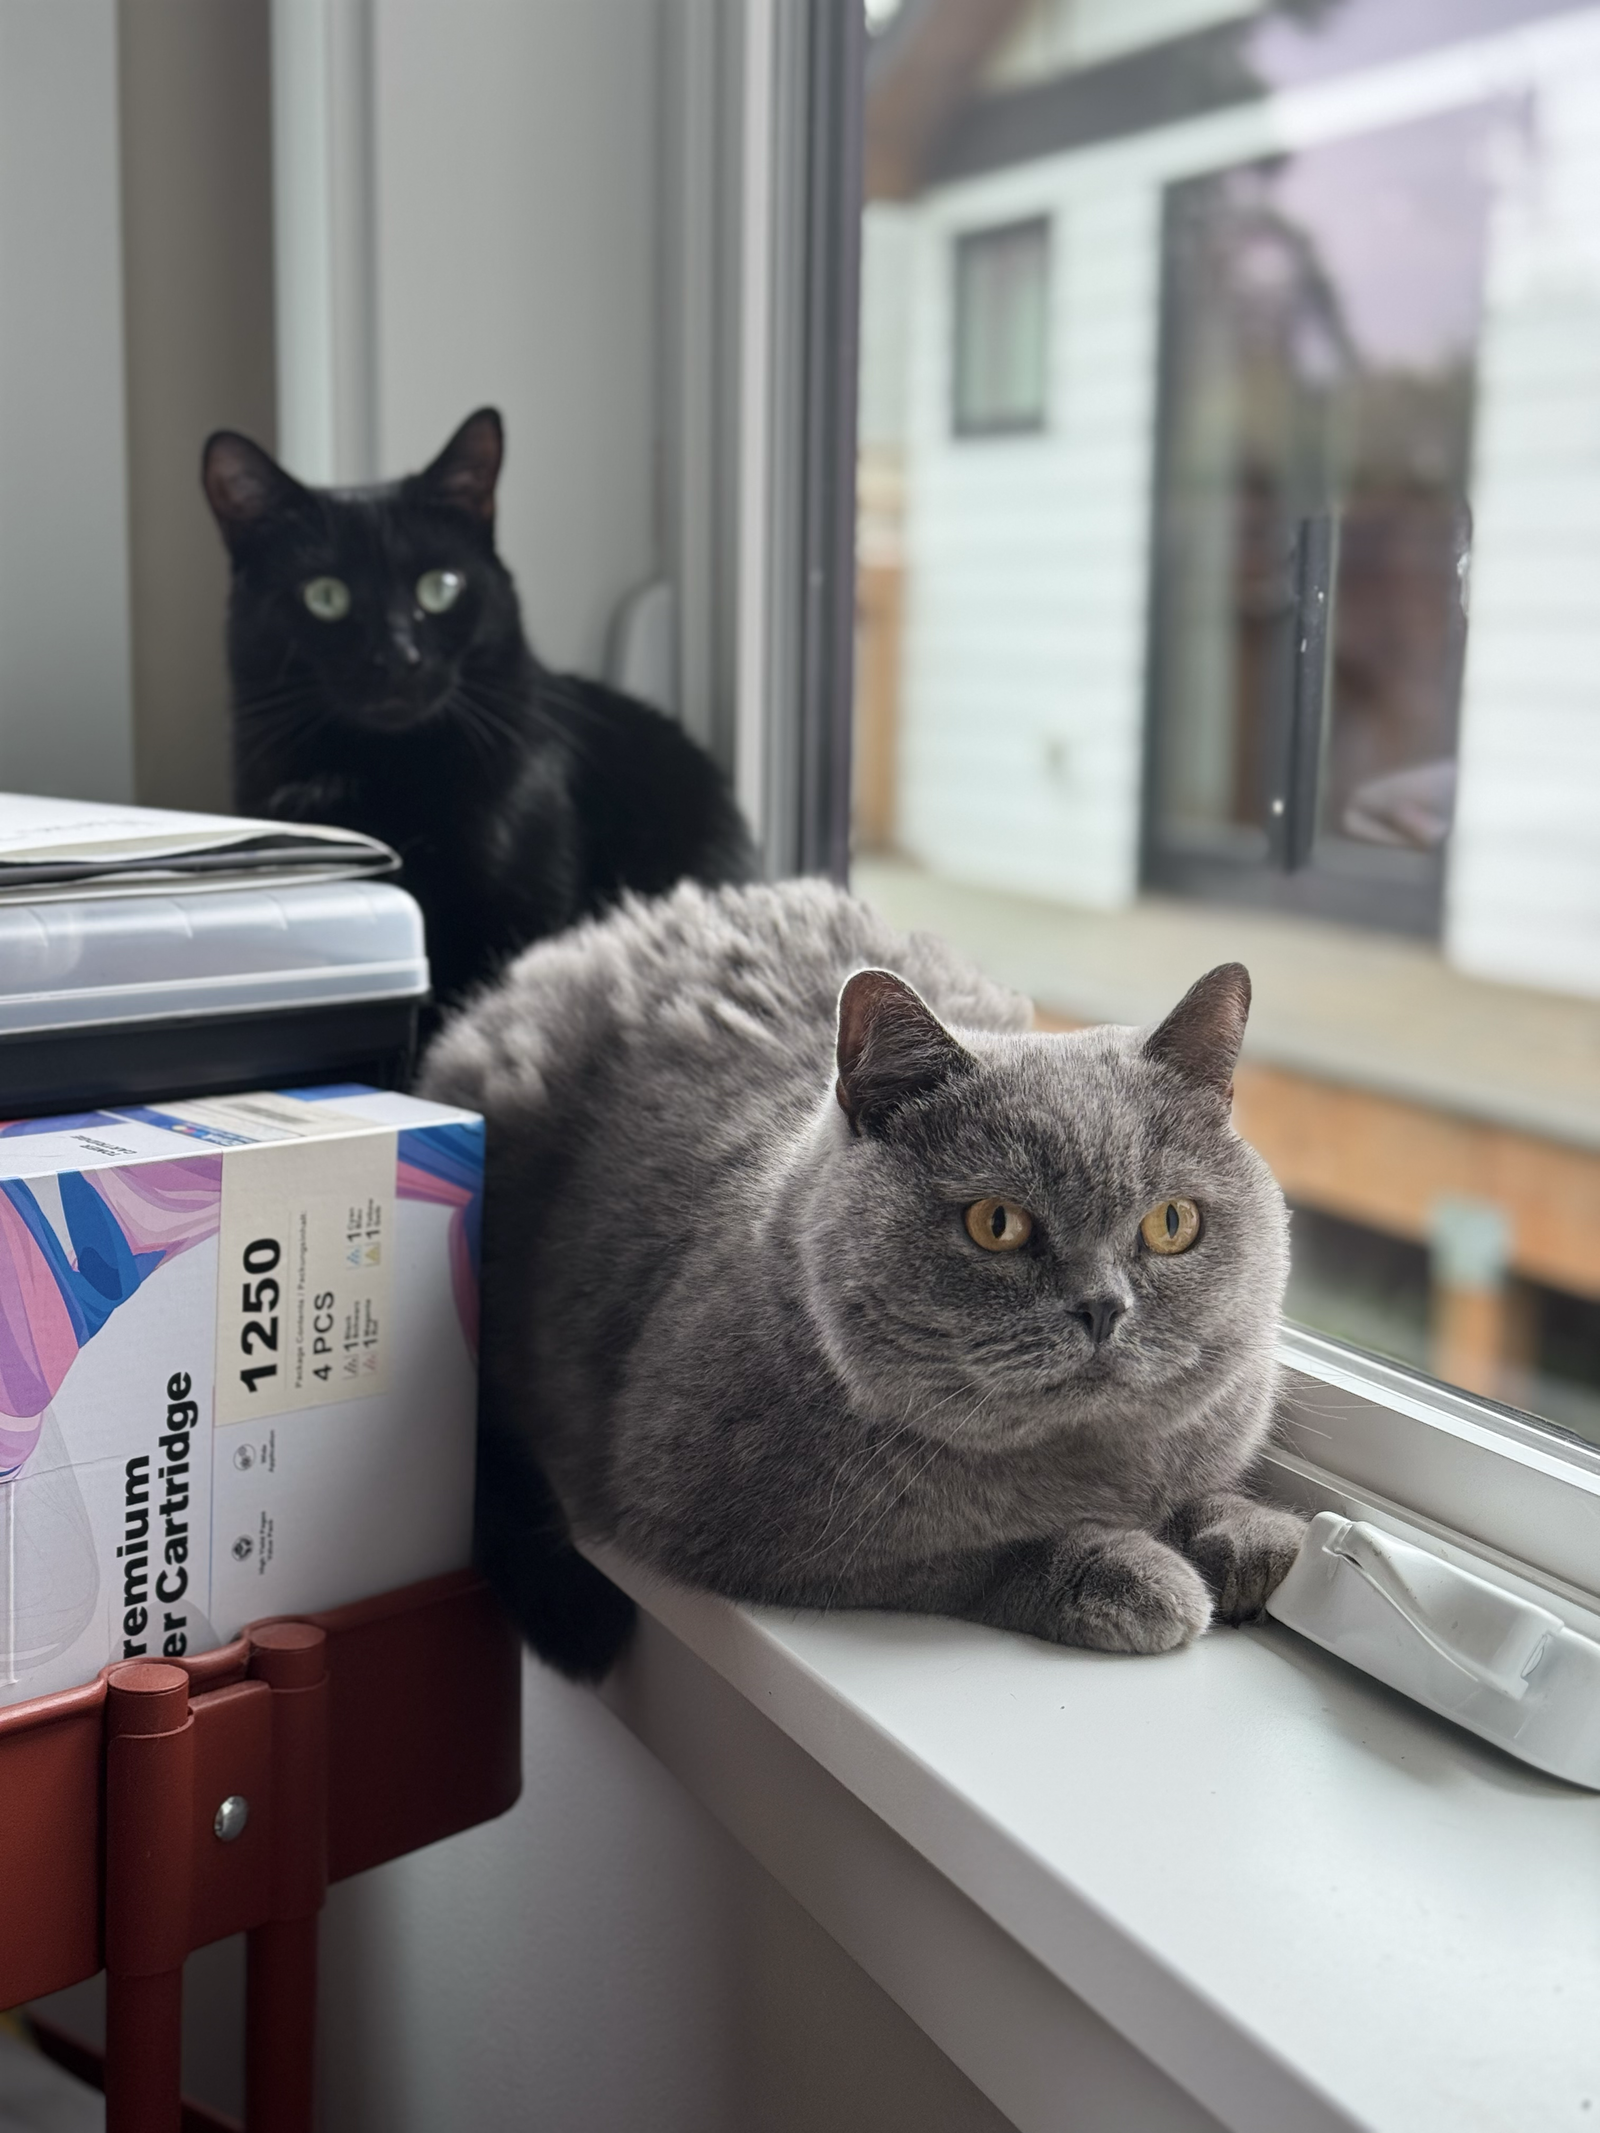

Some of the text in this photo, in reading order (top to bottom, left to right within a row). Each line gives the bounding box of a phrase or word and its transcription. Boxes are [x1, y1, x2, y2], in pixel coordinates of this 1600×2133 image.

[346, 1233, 362, 1242] 1
[365, 1230, 381, 1240] 1
[240, 1238, 281, 1393] 1250
[312, 1291, 335, 1381] 4 PCS
[343, 1342, 359, 1352] 1
[363, 1339, 378, 1348] 1
[155, 1371, 199, 1603] Cartridge
[116, 1455, 150, 1659] remium
